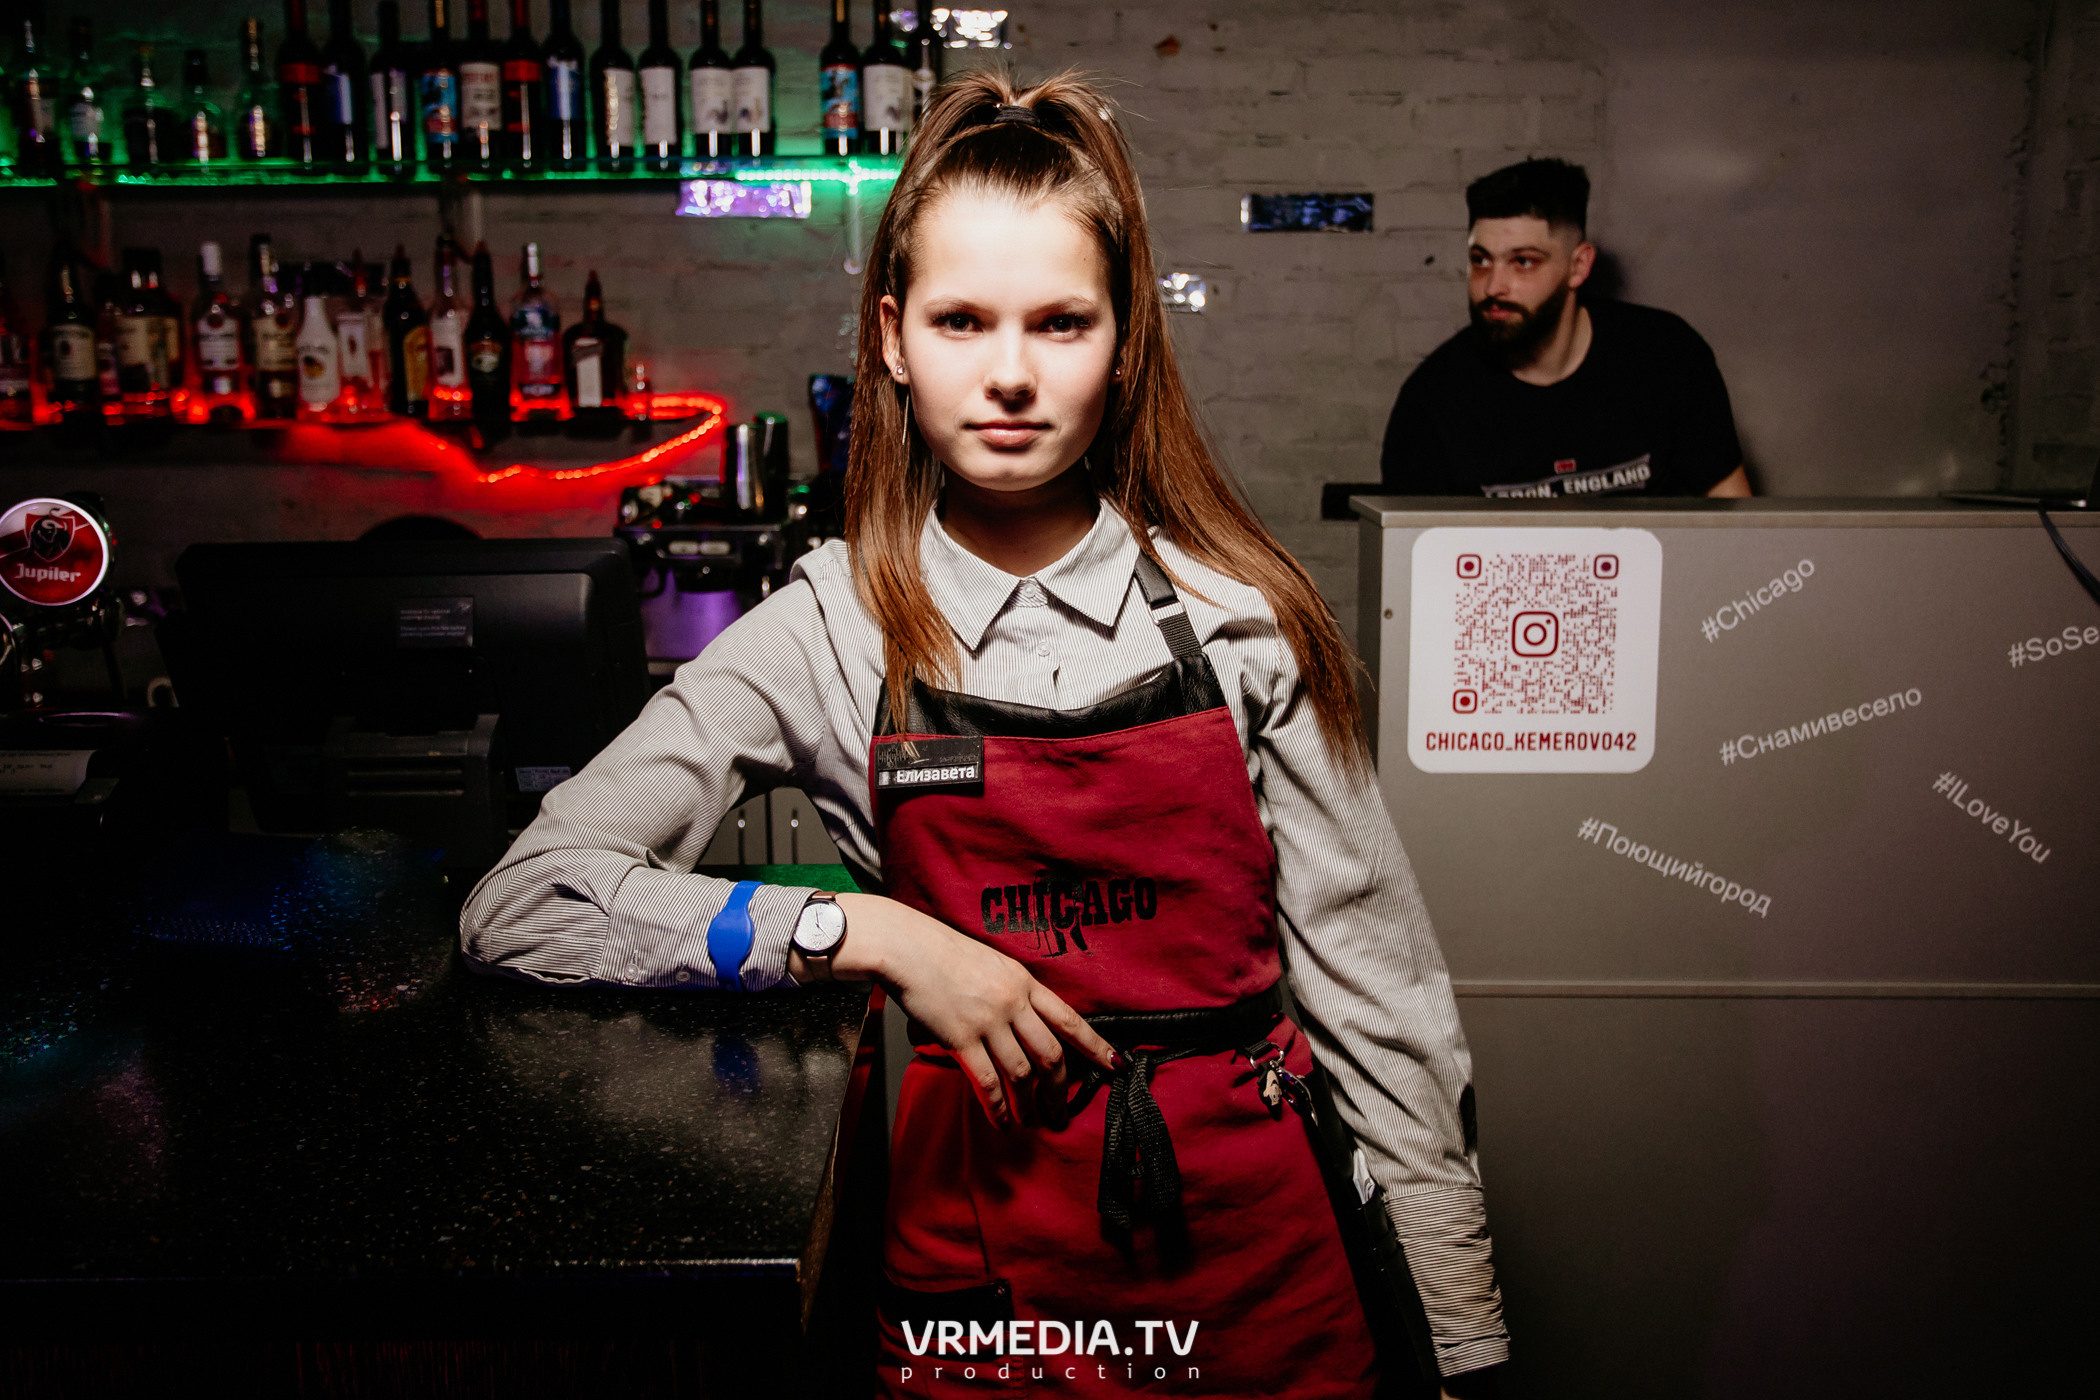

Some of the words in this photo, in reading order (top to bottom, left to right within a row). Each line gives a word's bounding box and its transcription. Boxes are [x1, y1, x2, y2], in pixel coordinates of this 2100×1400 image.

[1563, 463, 1651, 495] ENGLAND
[14, 563, 81, 582] Jupiler
[1701, 559, 1815, 643] #Chicago
[2007, 626, 2100, 668] #SoSe
[1719, 688, 1922, 766] #Снамивесело
[896, 766, 975, 784] Елизавета
[1932, 771, 2051, 864] #ILoveYou
[1577, 816, 1772, 918] #Поющийгород
[981, 876, 1158, 935] CHICAGO
